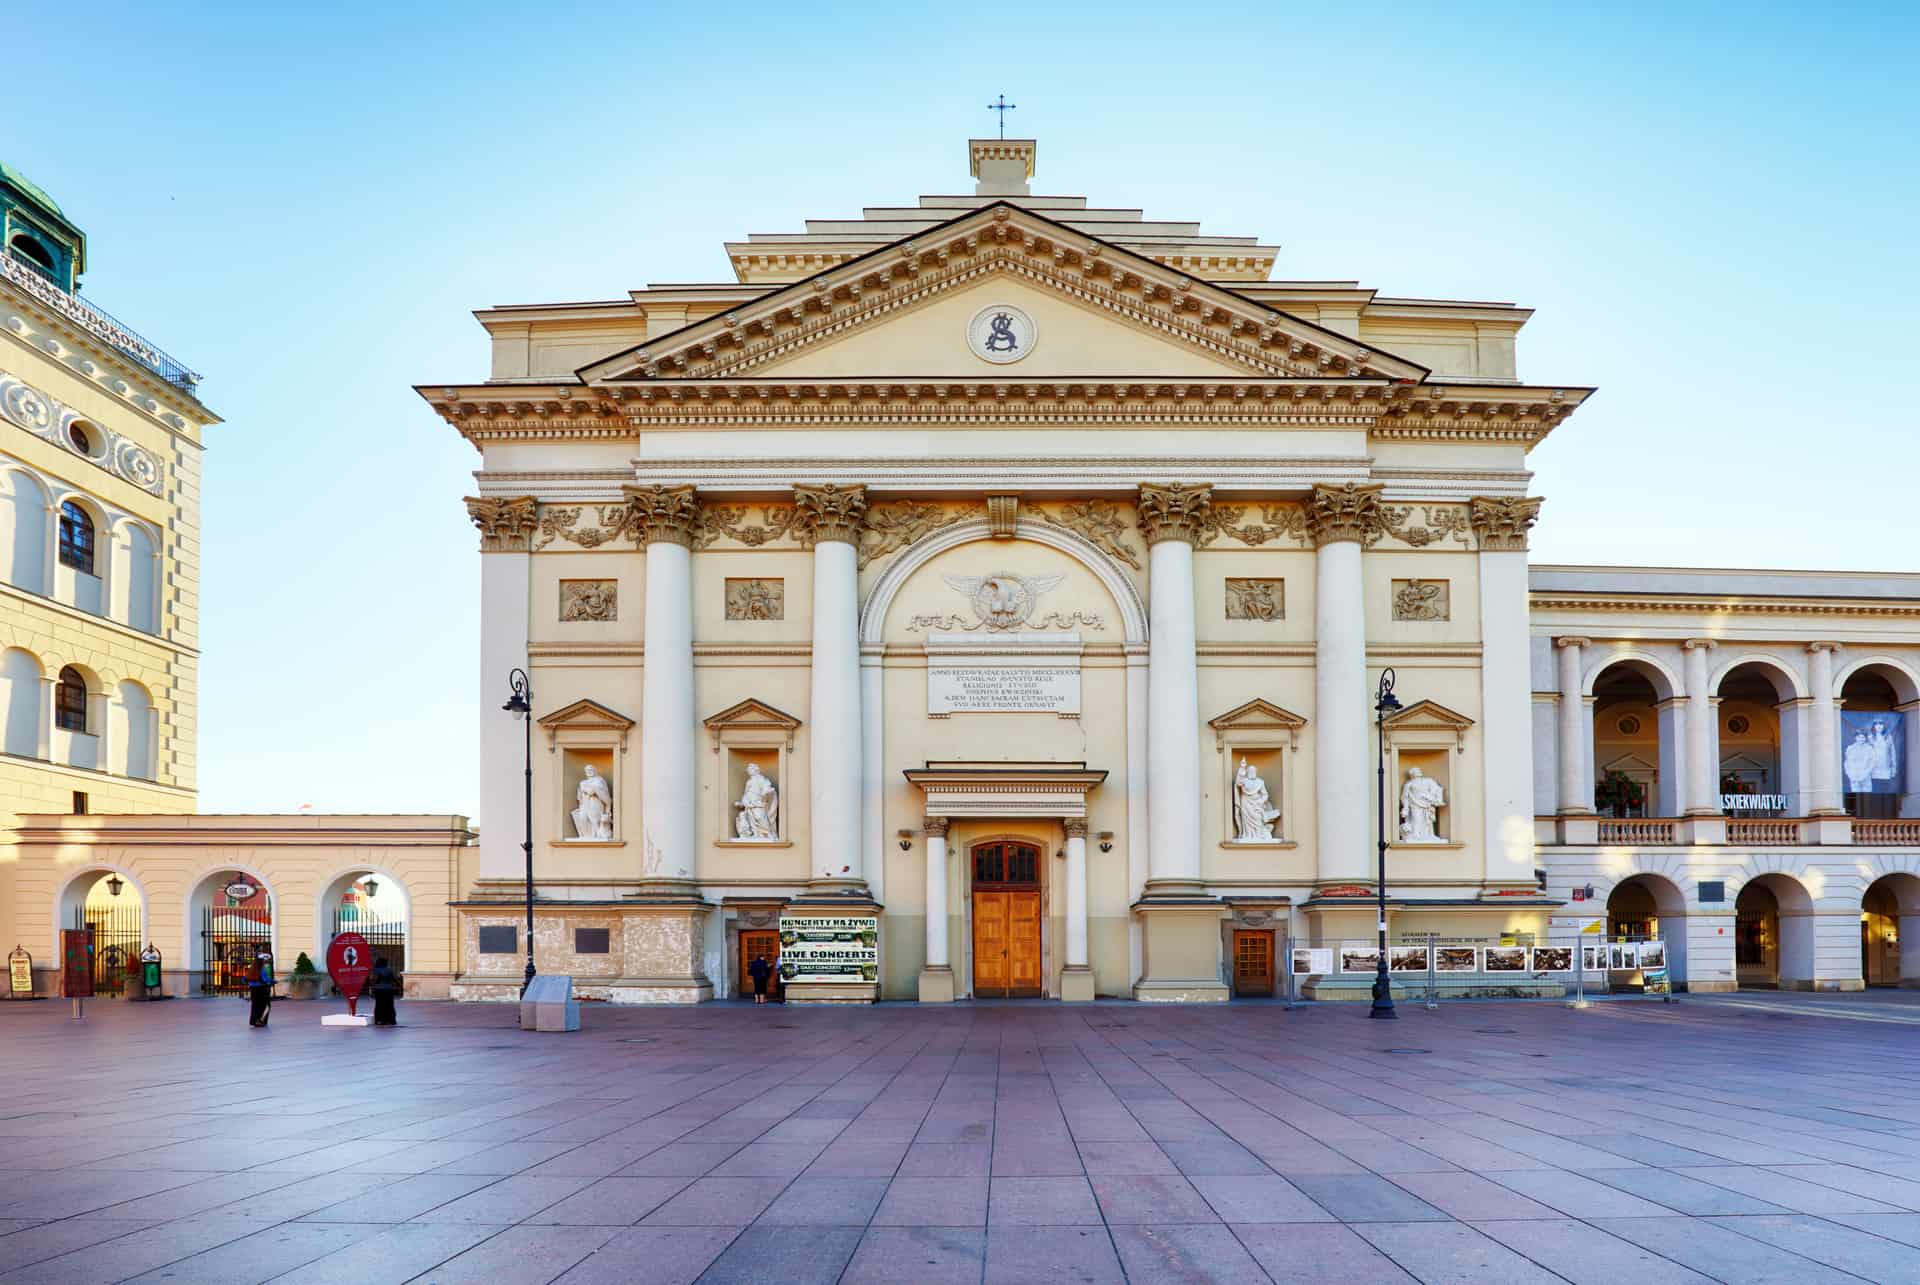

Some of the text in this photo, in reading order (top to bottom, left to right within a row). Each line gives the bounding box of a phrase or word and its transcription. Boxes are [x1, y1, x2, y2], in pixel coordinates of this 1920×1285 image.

[2, 254, 158, 364] TARAS WIDOKOWY
[11, 275, 80, 321] VIEWING
[847, 917, 875, 926] ŻYWO
